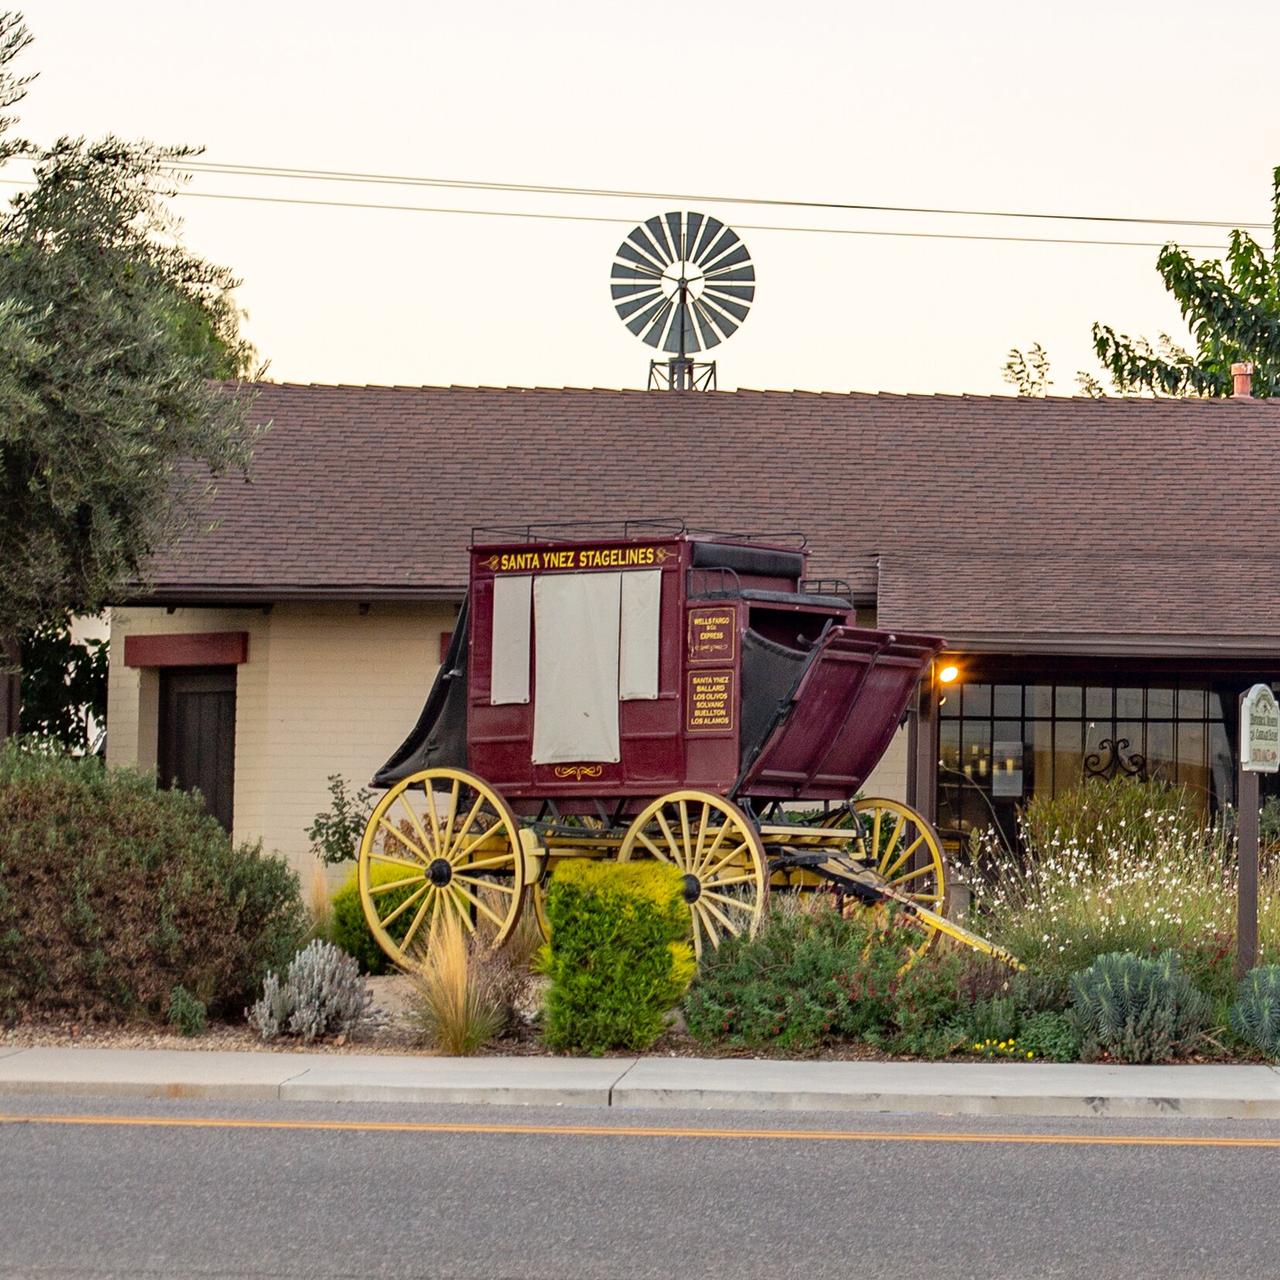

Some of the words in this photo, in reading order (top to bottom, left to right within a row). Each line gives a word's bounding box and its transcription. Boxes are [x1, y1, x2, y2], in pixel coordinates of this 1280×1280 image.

[501, 553, 540, 570] SANTA
[543, 551, 575, 569] YNEZ
[579, 548, 654, 567] STAGELINES
